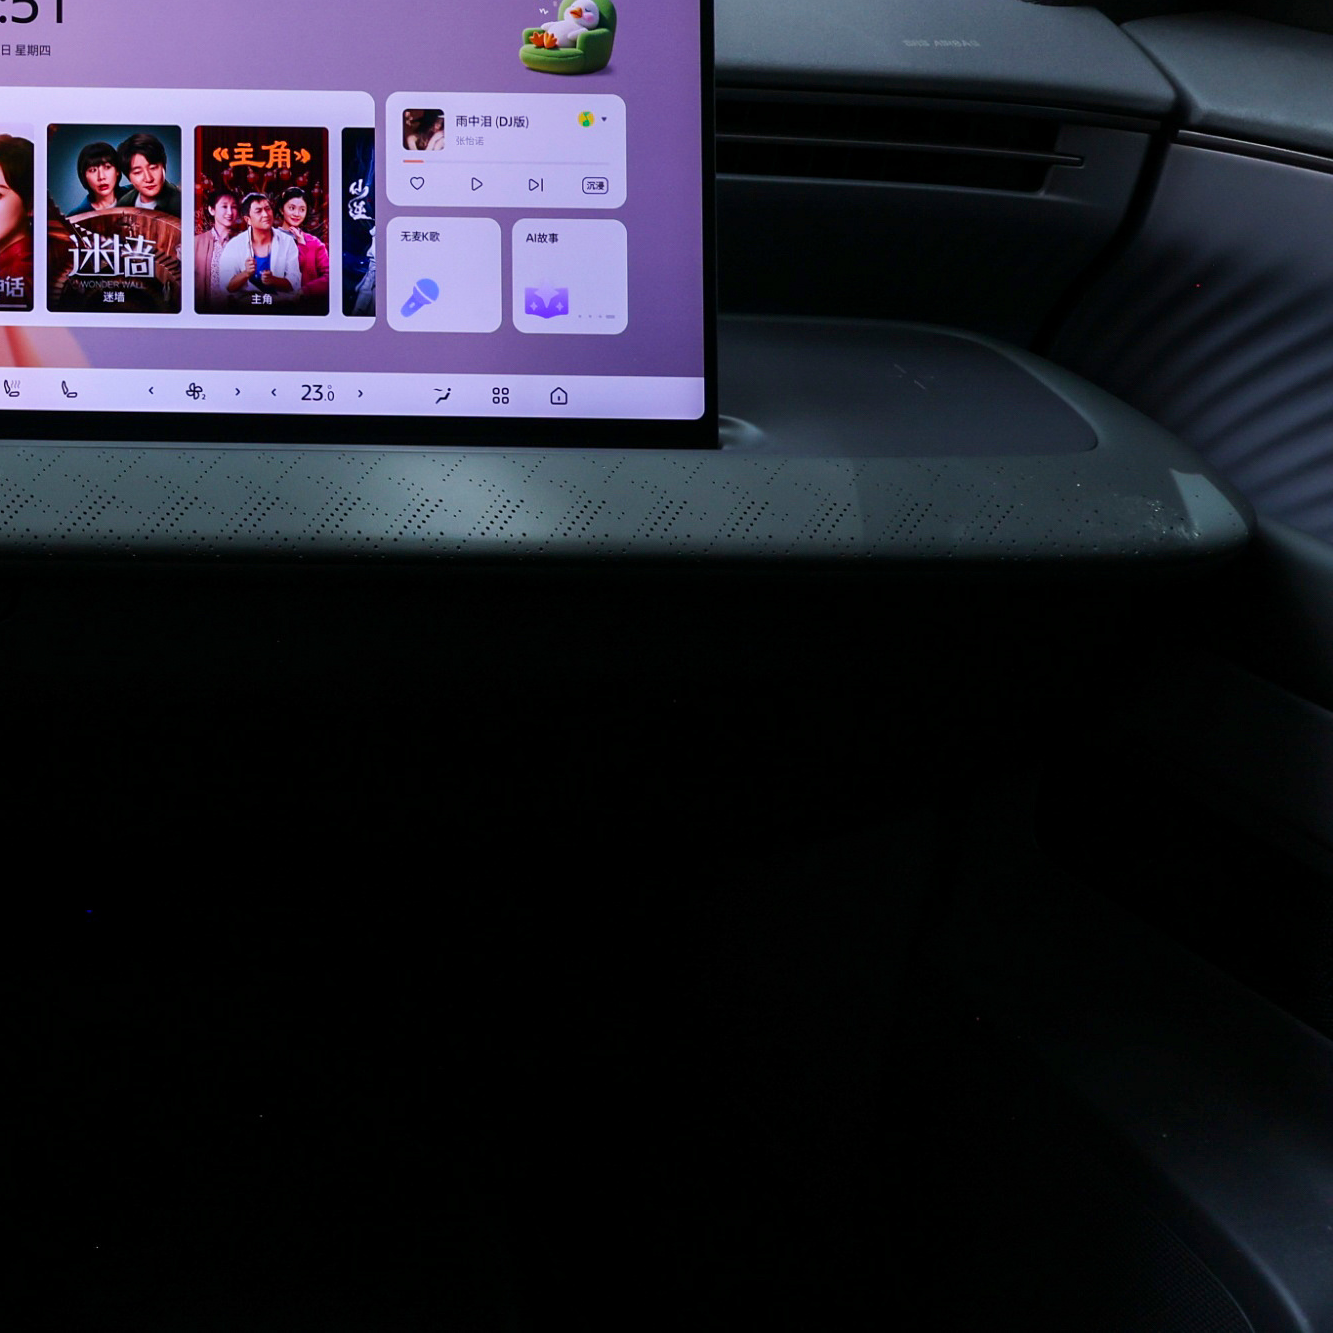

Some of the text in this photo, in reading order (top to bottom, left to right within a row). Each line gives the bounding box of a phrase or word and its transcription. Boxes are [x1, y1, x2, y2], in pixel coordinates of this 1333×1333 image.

[15, 44, 51, 57] 星期四
[455, 115, 530, 129] 雨中泪 (DJ版)
[455, 136, 485, 146] 张怡诺
[586, 181, 605, 191] 沉浸
[400, 231, 441, 243] 无麦K歌
[526, 233, 559, 244] AI故事
[68, 233, 157, 279] 迷墙
[80, 280, 146, 290] WONDER WALL
[103, 291, 125, 302] 迷墙
[251, 294, 273, 305] 主角
